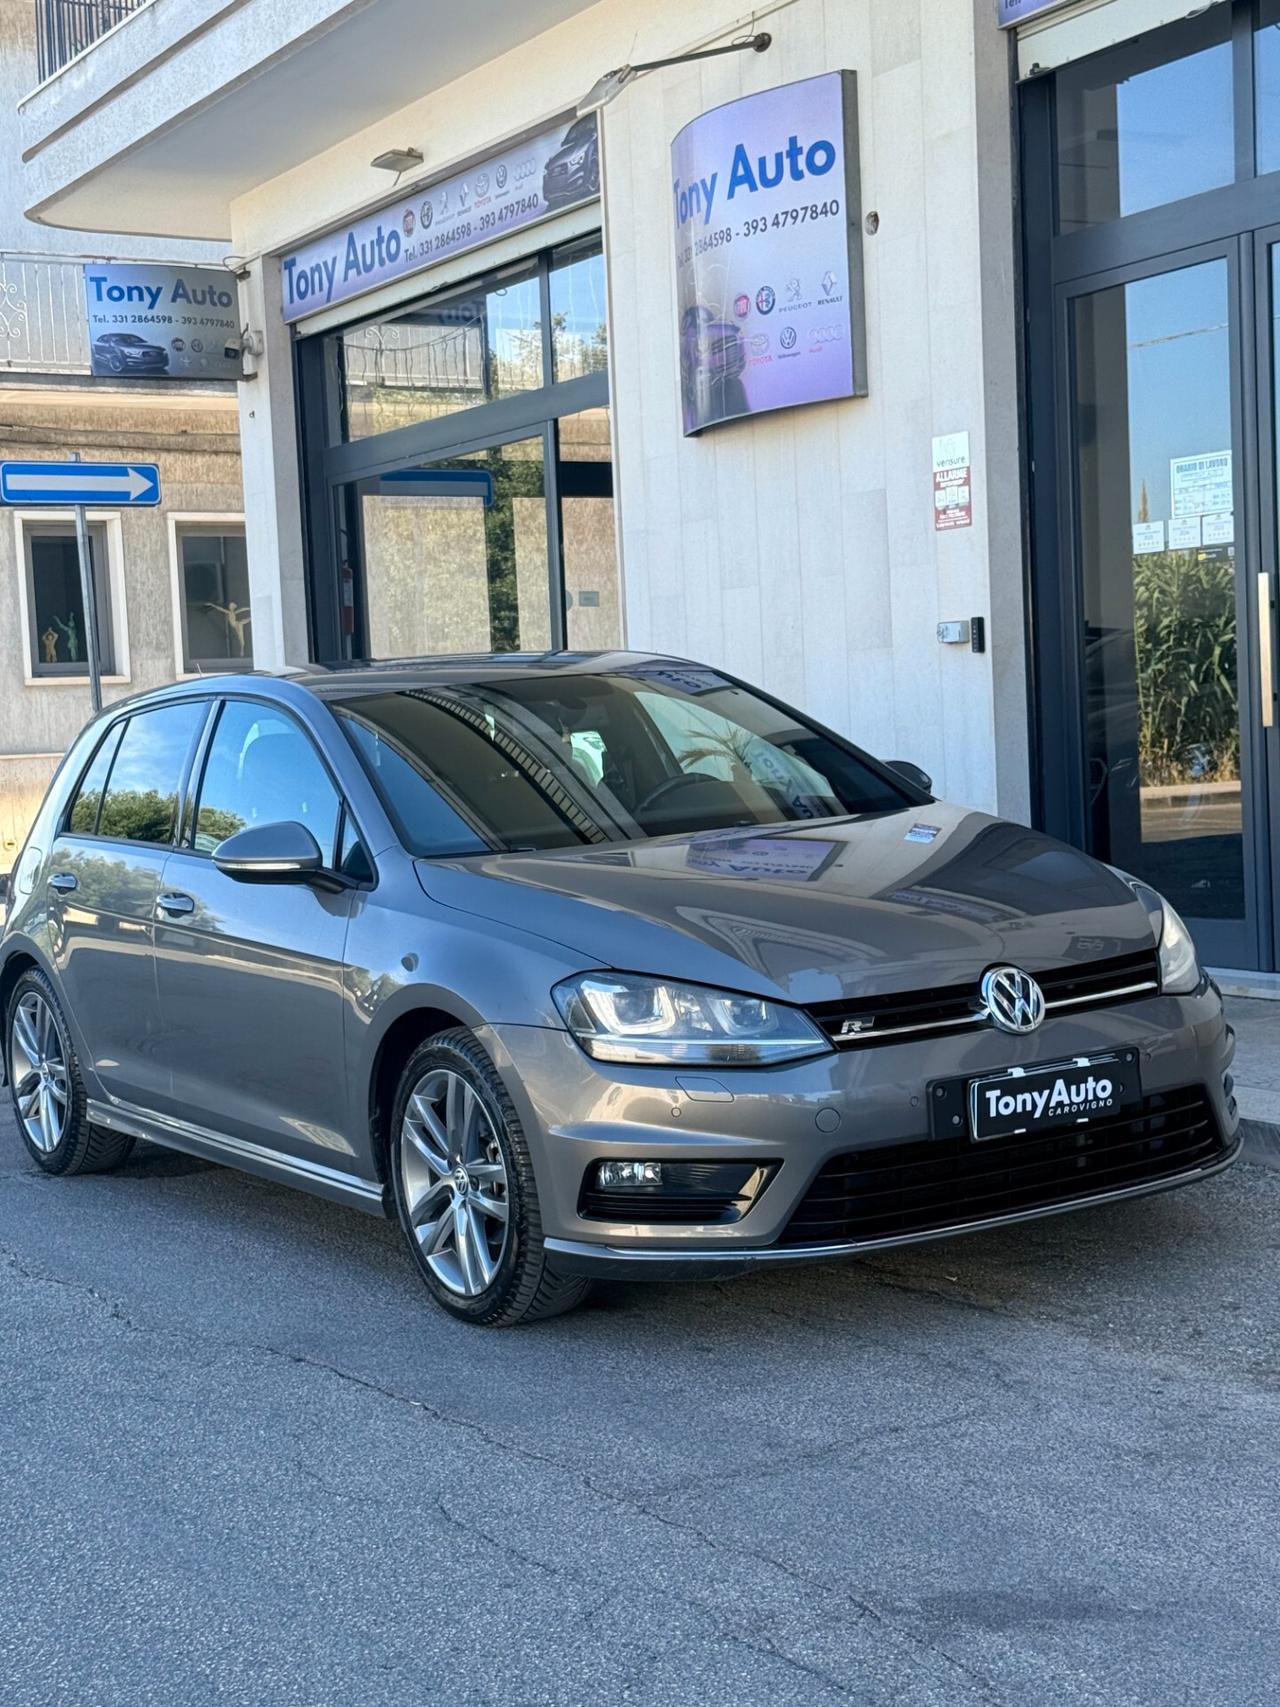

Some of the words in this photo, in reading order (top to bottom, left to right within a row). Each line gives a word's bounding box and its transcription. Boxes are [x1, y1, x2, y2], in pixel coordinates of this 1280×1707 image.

[673, 172, 718, 230] Tony
[727, 135, 836, 200] Auto
[404, 246, 418, 262] Tel.
[420, 240, 433, 256] 331
[435, 222, 472, 250] 2864598
[479, 211, 496, 232] 393
[497, 193, 539, 223] 4797840
[743, 217, 768, 237] 393
[771, 199, 840, 230] 4797840
[283, 256, 337, 304] Tony
[343, 225, 401, 282] Auto
[90, 276, 163, 310] Tony
[171, 278, 233, 308] Auto
[93, 315, 109, 324] Tel.
[112, 315, 128, 323] 331
[131, 315, 173, 324] 2864598
[181, 316, 198, 326] 393
[199, 317, 235, 329] 4797840
[1048, 1098, 1113, 1116] CAROVIGNO
